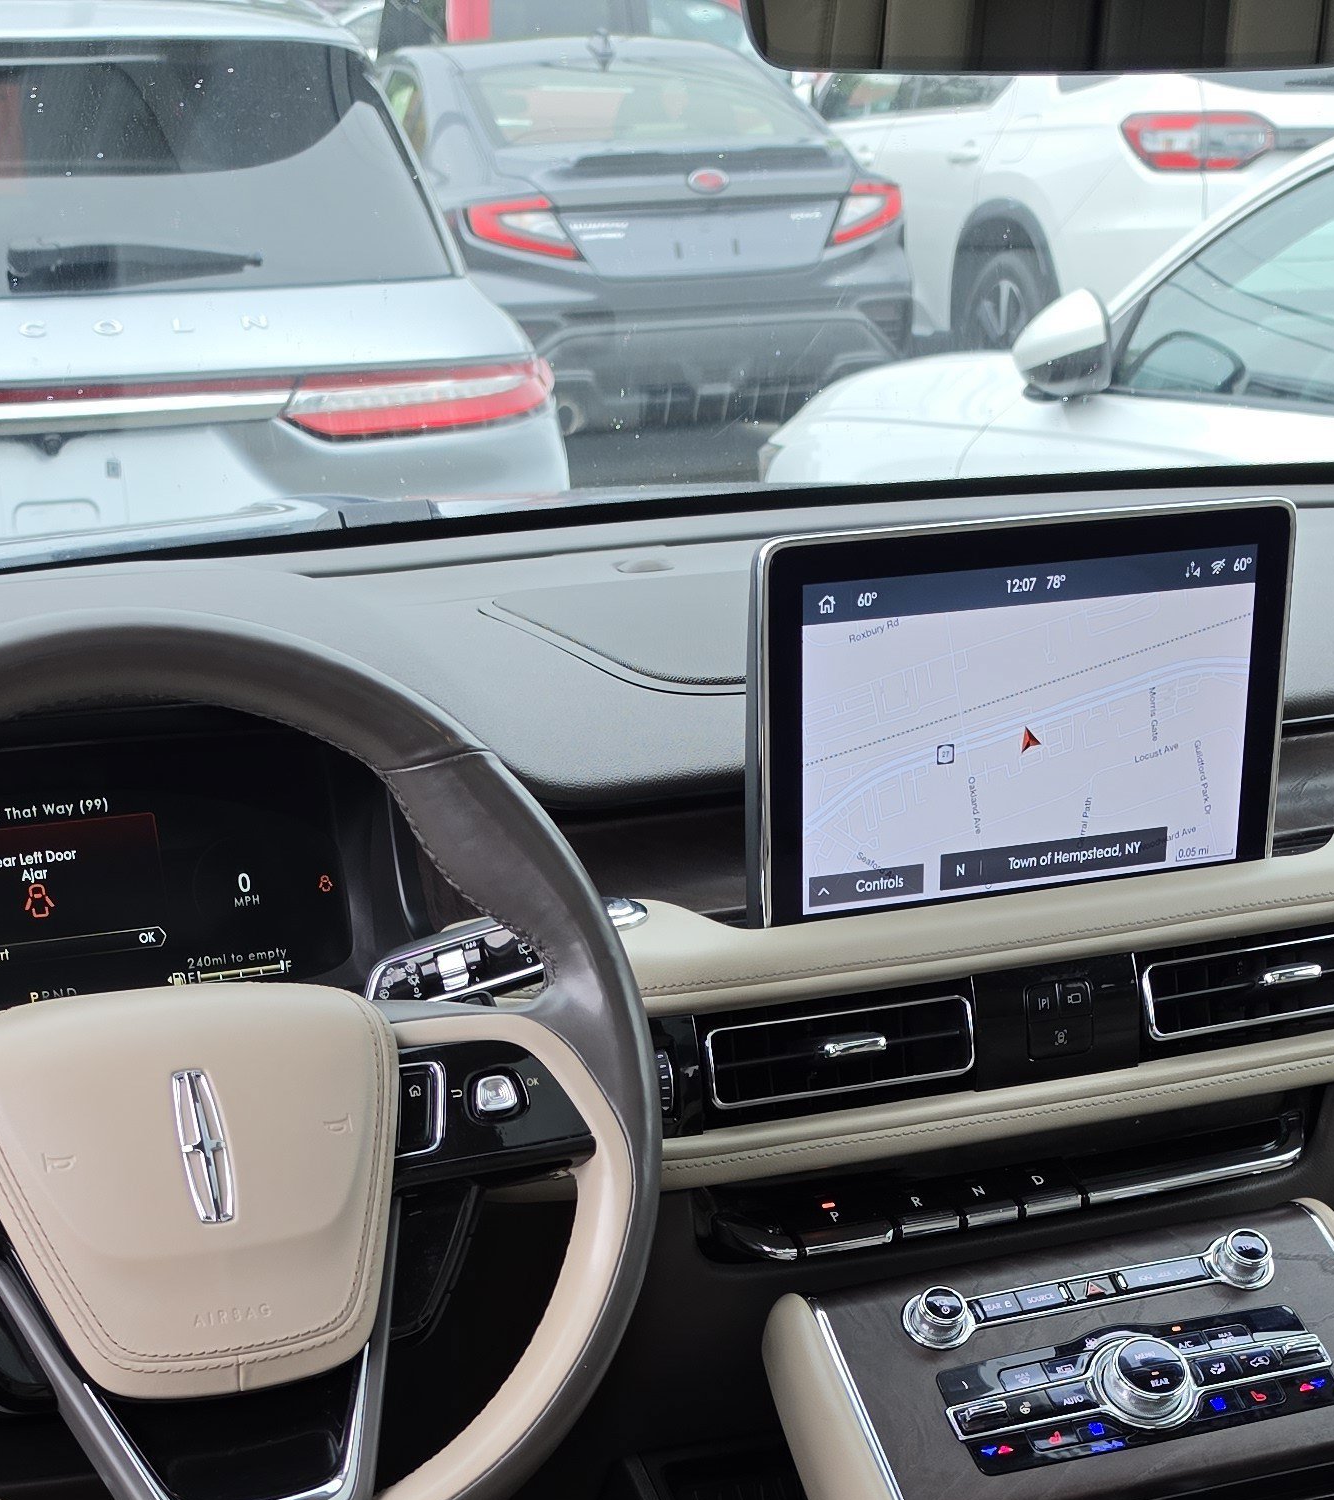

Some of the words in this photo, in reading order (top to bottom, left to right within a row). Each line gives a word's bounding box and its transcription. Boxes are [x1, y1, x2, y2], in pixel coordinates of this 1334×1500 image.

[1006, 578, 1037, 594] 12:07
[848, 624, 885, 644] Roxbury
[886, 618, 900, 630] Rd
[1150, 719, 1158, 742] Gate
[941, 750, 950, 758] 27
[1134, 748, 1162, 764] Locust
[1164, 743, 1179, 754] Ave
[1194, 740, 1207, 782] Guildford
[1201, 782, 1210, 804] Park
[968, 776, 980, 815] Oakland
[4, 805, 38, 820] That
[42, 802, 74, 817] Way
[79, 797, 109, 813] (99)
[1082, 797, 1092, 818] Path
[973, 817, 981, 835] Ave
[1182, 826, 1197, 837] Ave
[19, 851, 43, 866] Left
[45, 849, 77, 864] Door
[956, 863, 966, 877] N
[1008, 857, 1037, 870] Town
[1039, 851, 1052, 866] of
[1054, 844, 1122, 864] Hempstead,
[1125, 841, 1142, 855] NY
[1178, 848, 1197, 859] 0.05
[1198, 846, 1209, 856] mi
[21, 868, 48, 884] Ajar
[237, 872, 251, 893] 0
[855, 875, 904, 893] Controls
[234, 894, 260, 908] MPH
[139, 931, 157, 945] OK
[231, 953, 243, 963] to
[248, 947, 287, 961] empty
[527, 1077, 539, 1087] OK
[1031, 1175, 1045, 1186] D
[971, 1185, 986, 1197] N
[911, 1196, 923, 1207] R
[829, 1211, 839, 1222] P
[1026, 1293, 1055, 1304] SOURCE
[983, 1303, 1002, 1311] REAR
[193, 1303, 273, 1329] AIRBAG
[1218, 1331, 1233, 1339] MAX
[1178, 1340, 1194, 1350] A/C
[1134, 1351, 1156, 1360] MENU
[1150, 1378, 1170, 1388] REAR
[1063, 1395, 1084, 1406] AUTO
